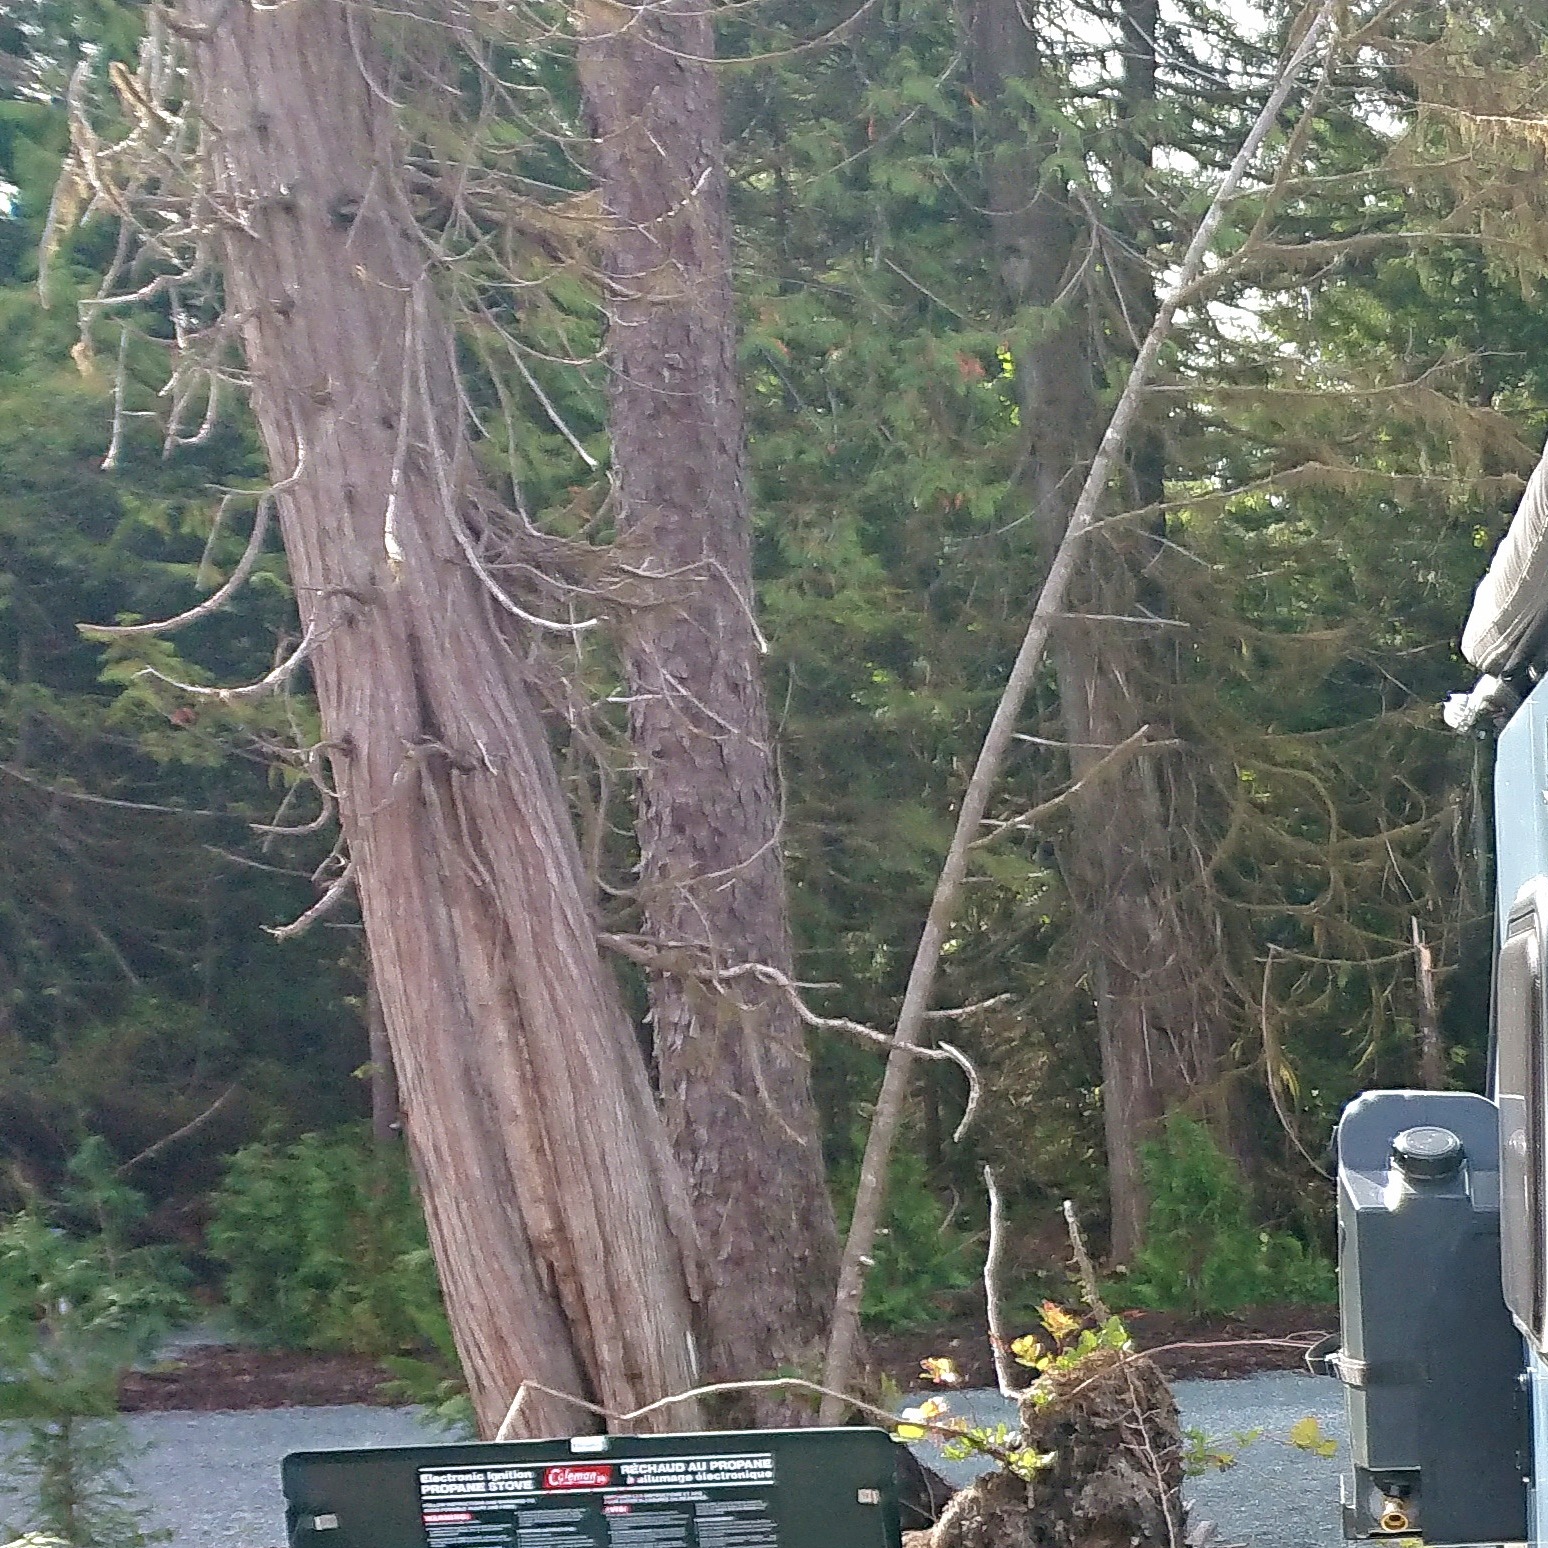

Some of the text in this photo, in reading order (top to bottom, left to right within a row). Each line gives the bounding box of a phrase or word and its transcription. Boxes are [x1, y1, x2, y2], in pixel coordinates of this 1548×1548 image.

[688, 1461, 707, 1473] AU
[709, 1459, 773, 1471] PROPANE
[420, 1470, 534, 1484] Electronic Ignition
[548, 1468, 598, 1486] Coleman
[636, 1472, 693, 1484] allumage
[420, 1480, 534, 1494] PROPANE STOVE
